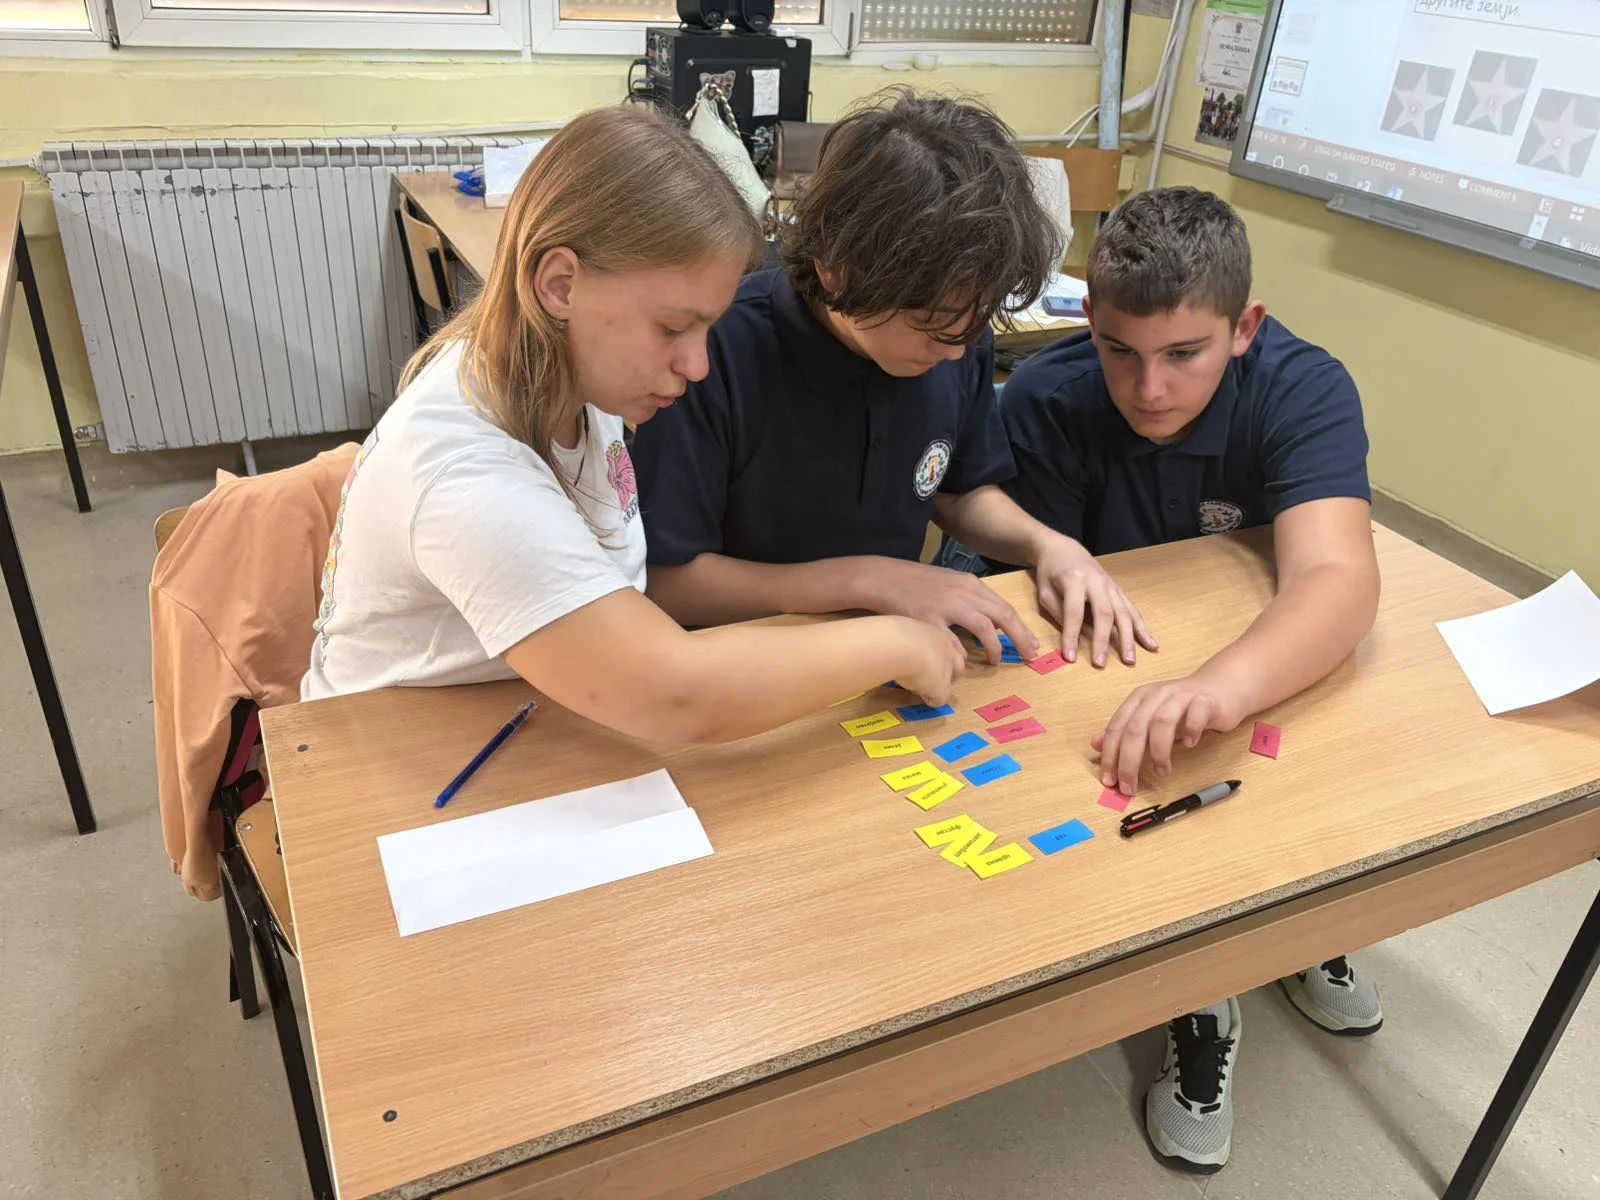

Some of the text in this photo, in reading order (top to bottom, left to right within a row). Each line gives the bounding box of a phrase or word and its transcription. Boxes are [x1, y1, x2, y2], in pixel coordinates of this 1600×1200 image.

[1418, 170, 1518, 203] NOTES COMMENTS
[954, 832, 982, 858] автомобил
